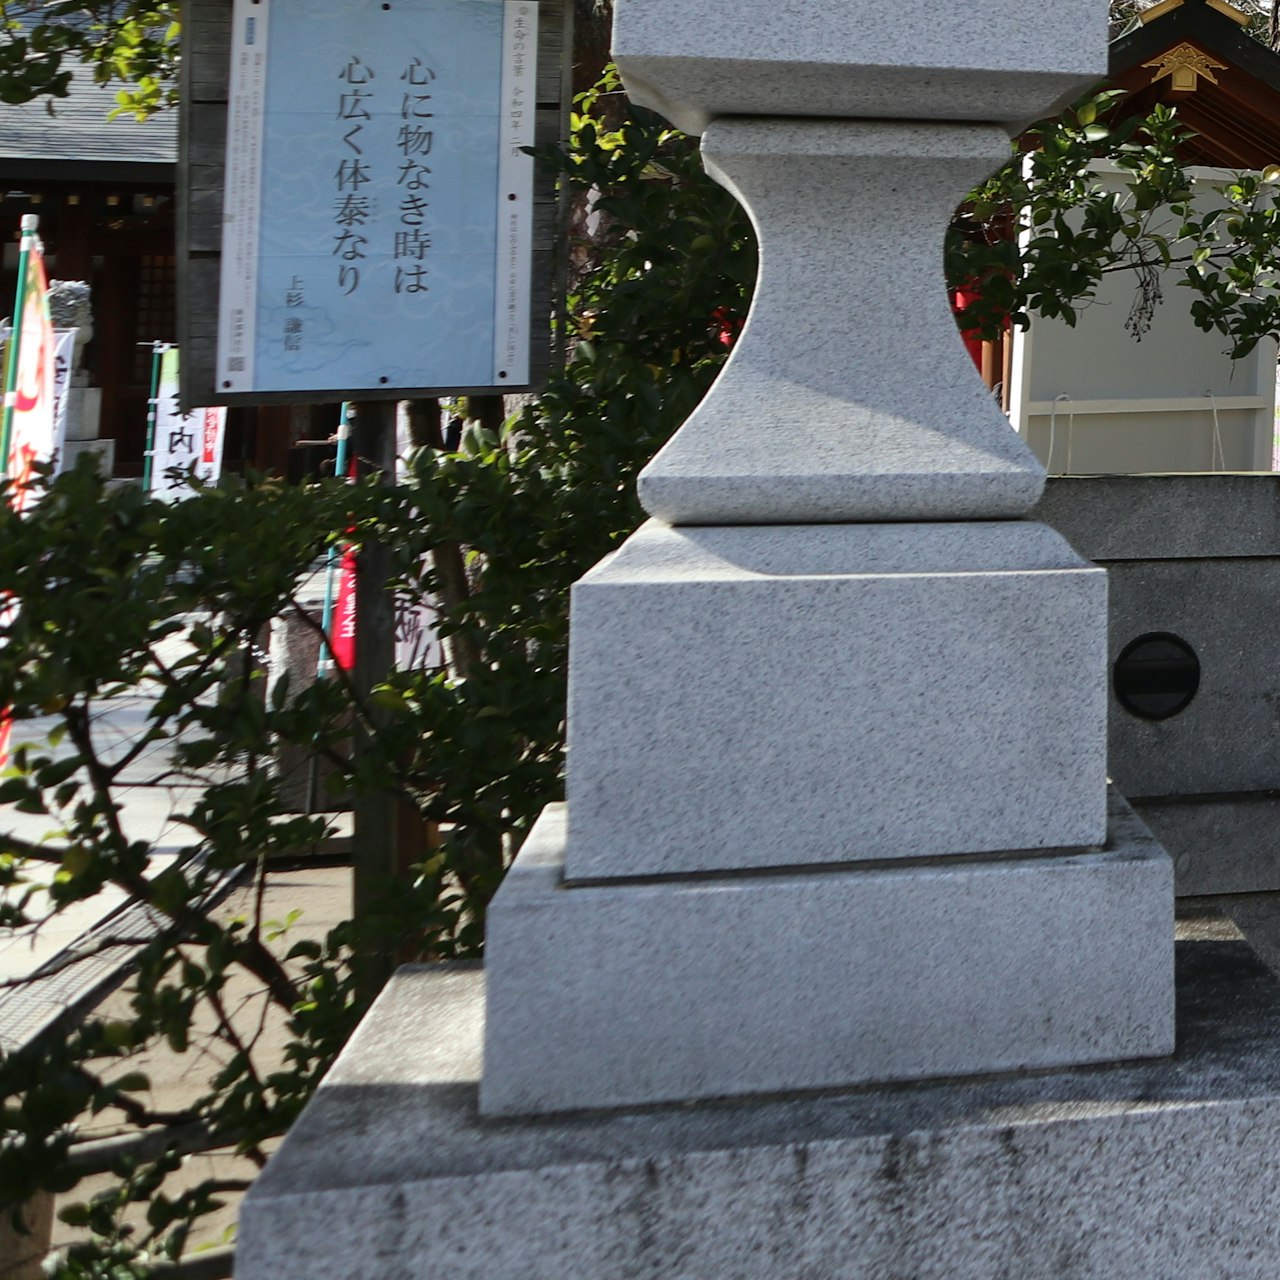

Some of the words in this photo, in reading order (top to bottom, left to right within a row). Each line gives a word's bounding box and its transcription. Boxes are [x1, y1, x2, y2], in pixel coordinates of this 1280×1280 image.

[285, 274, 305, 308] 上杉
[332, 55, 375, 297] 心広く体泰なり
[393, 56, 436, 295] 心に物なき時は
